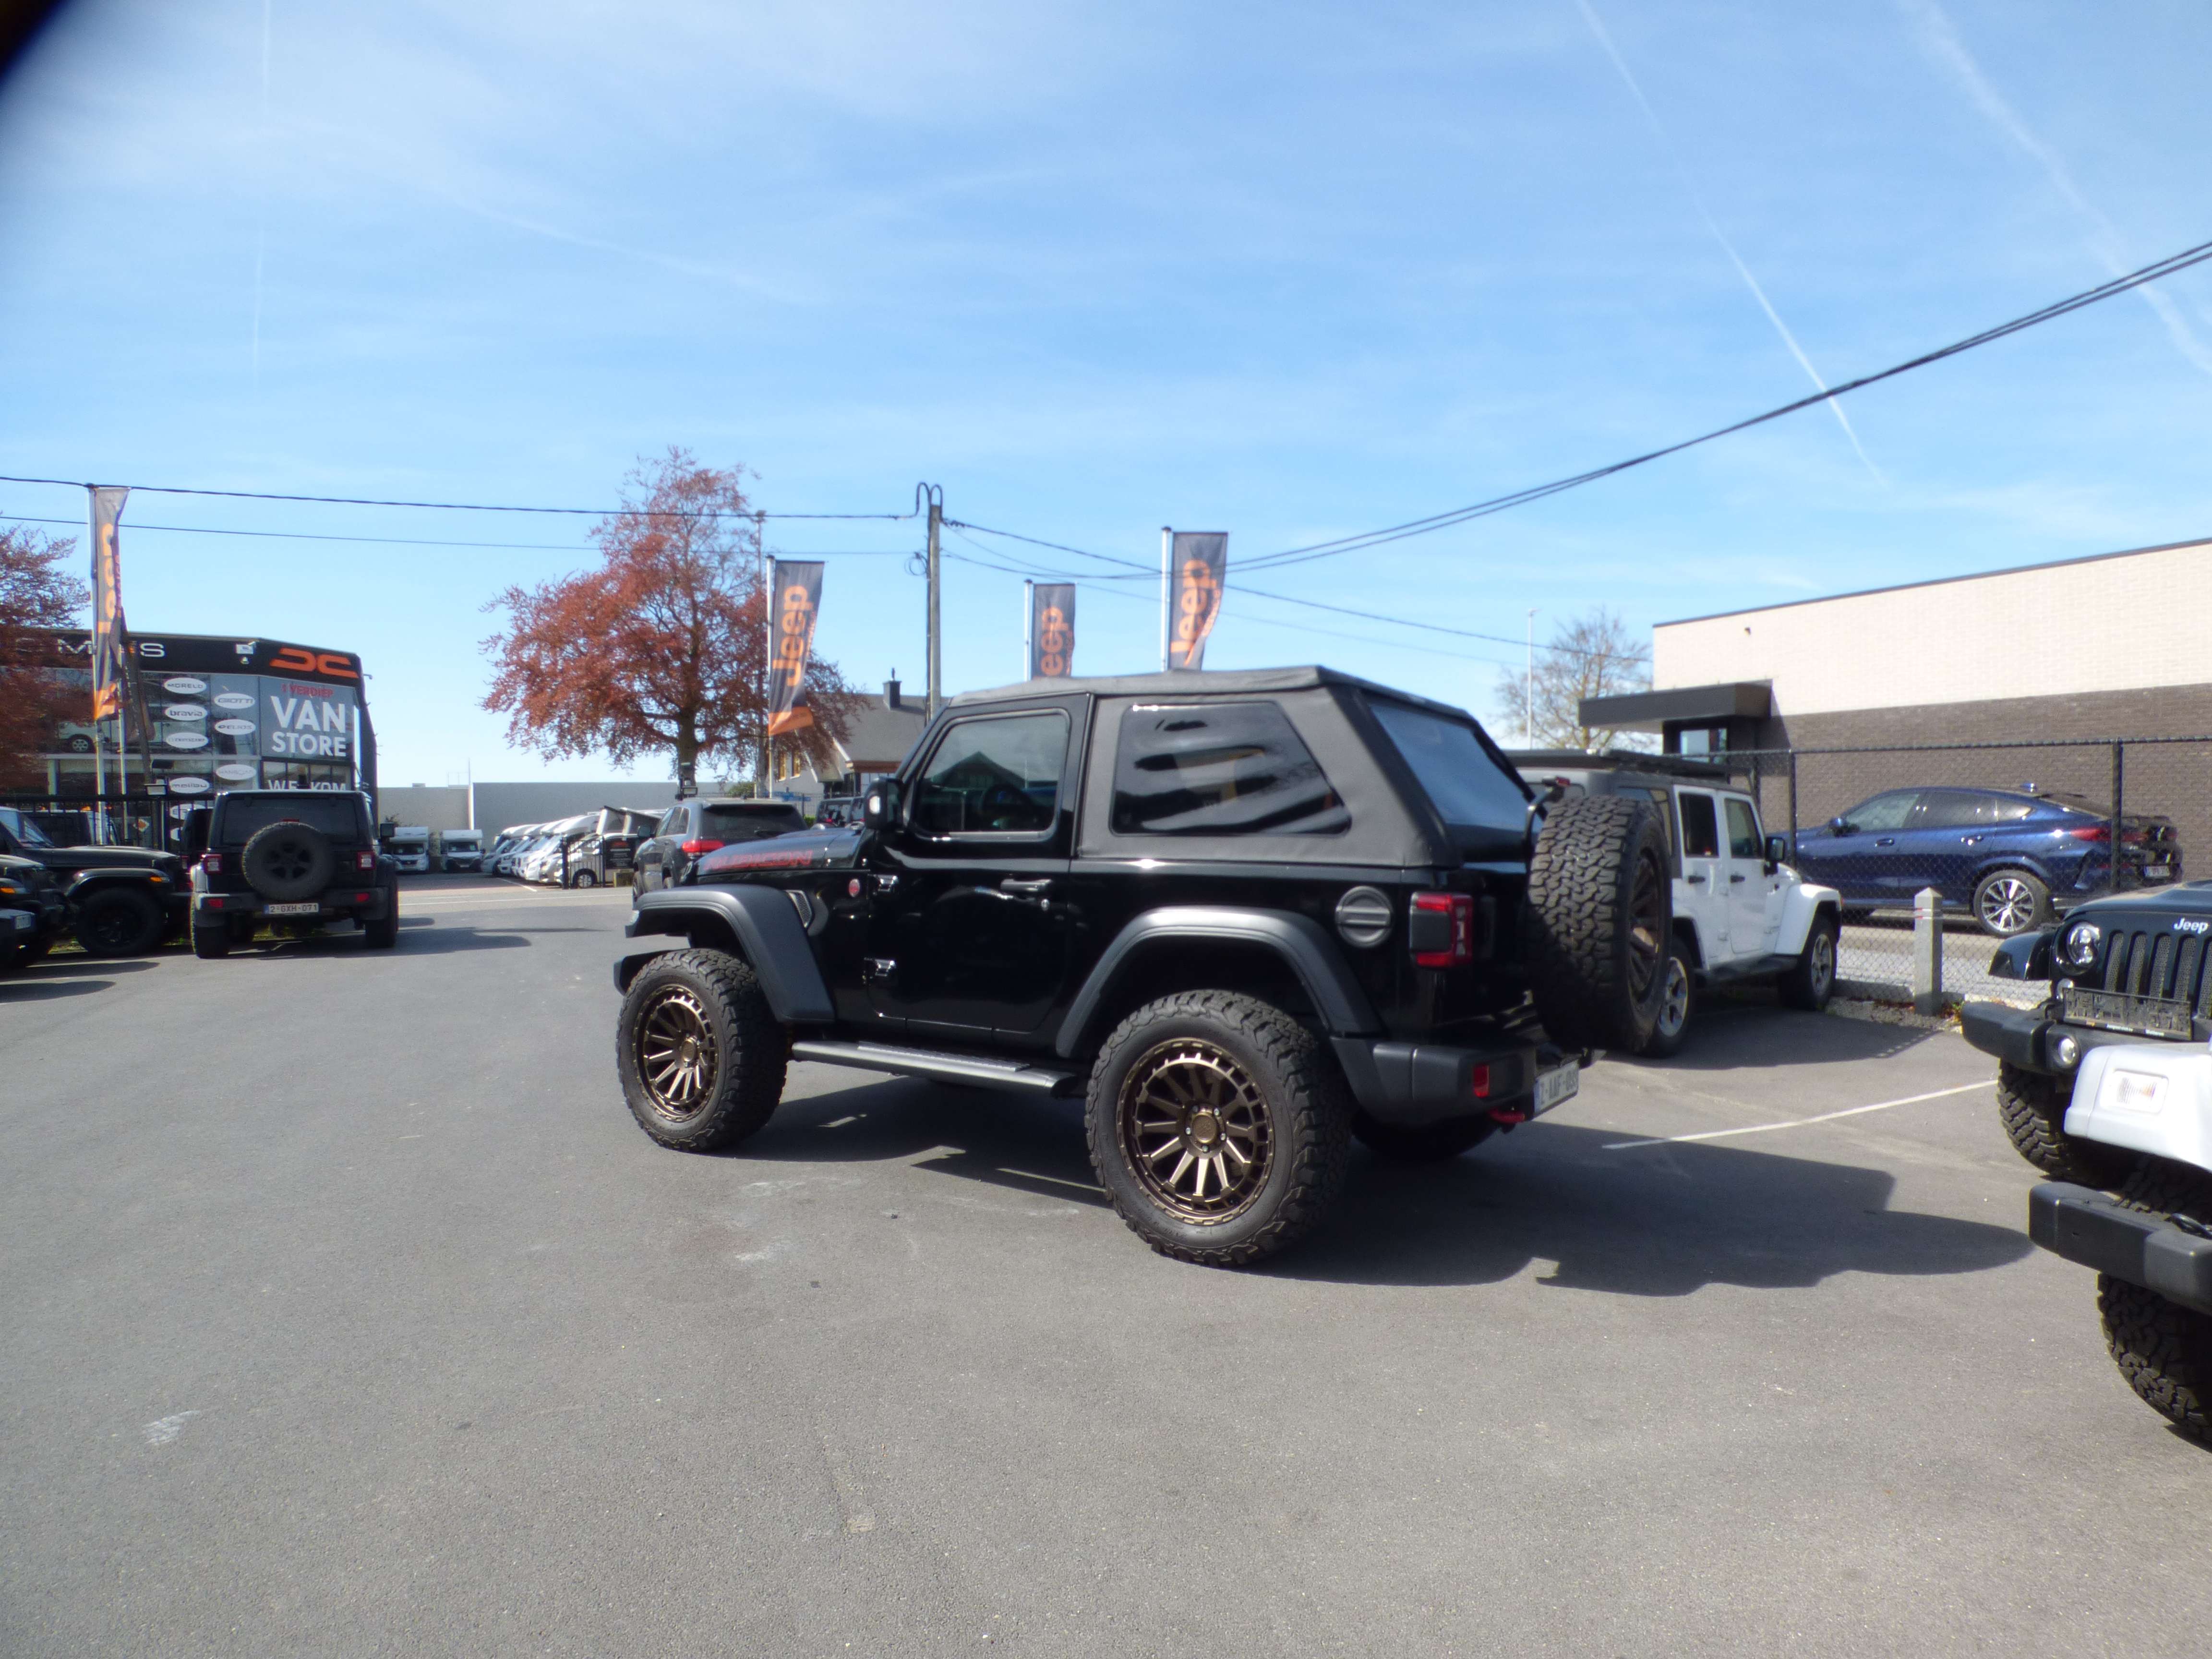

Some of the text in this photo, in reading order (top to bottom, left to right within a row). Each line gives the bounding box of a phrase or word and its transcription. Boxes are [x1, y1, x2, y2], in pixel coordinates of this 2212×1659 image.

[772, 585, 813, 686] Jeep
[1041, 606, 1069, 676] eep
[270, 696, 346, 733] VAN
[272, 731, 347, 757] STORE
[2173, 917, 2208, 934] Jeep
